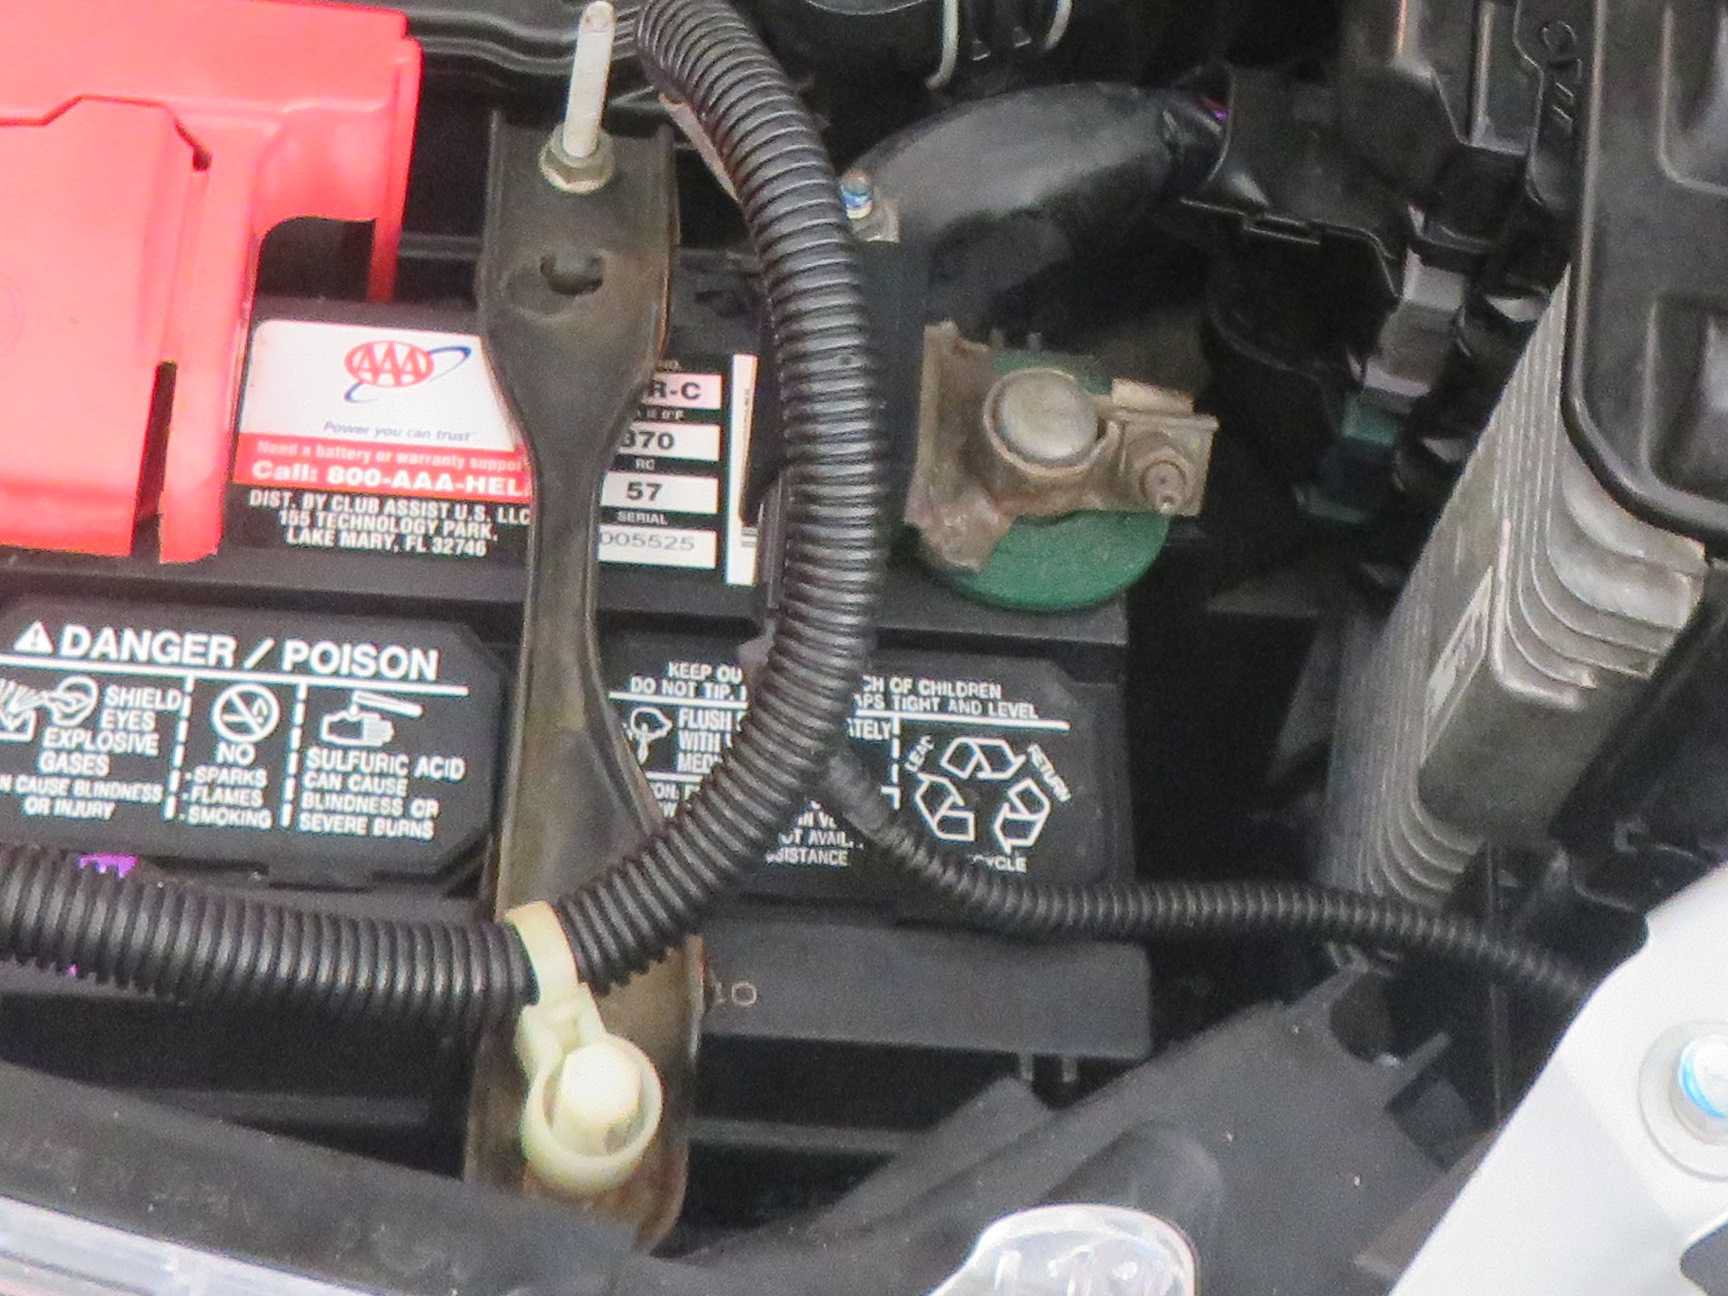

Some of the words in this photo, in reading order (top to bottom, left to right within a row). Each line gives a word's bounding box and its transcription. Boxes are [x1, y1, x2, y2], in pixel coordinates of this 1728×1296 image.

[349, 341, 433, 386] AAA
[323, 421, 370, 438] Power
[375, 425, 401, 441] you
[406, 428, 431, 440] can
[436, 428, 471, 442] trust
[256, 439, 297, 456] Need
[315, 443, 370, 465] battery
[375, 449, 392, 462] or
[396, 449, 465, 472] warranty
[635, 458, 656, 471] RC
[251, 461, 318, 484] Call:
[626, 481, 663, 502] 57
[249, 489, 297, 508] DIST.
[302, 492, 328, 509] BY
[332, 494, 379, 515] CLUB
[384, 497, 449, 520] ASSIST
[454, 503, 492, 523] U.S.
[616, 511, 669, 527] SERIAL
[279, 509, 312, 527] 155
[316, 511, 439, 536] TECHNOLOGY
[286, 526, 336, 547] LAKE
[340, 529, 400, 554] MARY,
[405, 534, 428, 552] FL
[60, 623, 238, 669] DANGER
[282, 639, 440, 681] POISON
[668, 661, 712, 682] KEEP
[889, 676, 912, 695] OF
[918, 678, 1003, 700] CHILDREN
[105, 684, 181, 712] SHIELD
[630, 675, 656, 695] DO
[661, 678, 697, 698] NOT
[892, 694, 941, 713] TIGHT
[948, 699, 983, 716] AND
[988, 702, 1040, 720] LEVEL
[101, 710, 156, 732] EYES
[678, 707, 732, 729] FLUSH
[43, 727, 160, 757] EXPLOSIVE
[216, 741, 256, 767] NO
[678, 729, 721, 753] WITH
[39, 751, 110, 777] GASES
[304, 746, 410, 777] SULFURIC
[414, 754, 466, 781] ACID
[15, 776, 71, 797] CAUSE
[73, 780, 164, 804] BLINDNESS
[302, 771, 342, 791] CAN
[347, 775, 409, 798] CAUSE
[24, 796, 51, 816] OR
[54, 799, 116, 821] INJURY
[301, 791, 404, 816] BLINDNESS
[299, 812, 369, 836] SEVERE
[373, 816, 435, 841] BURNS
